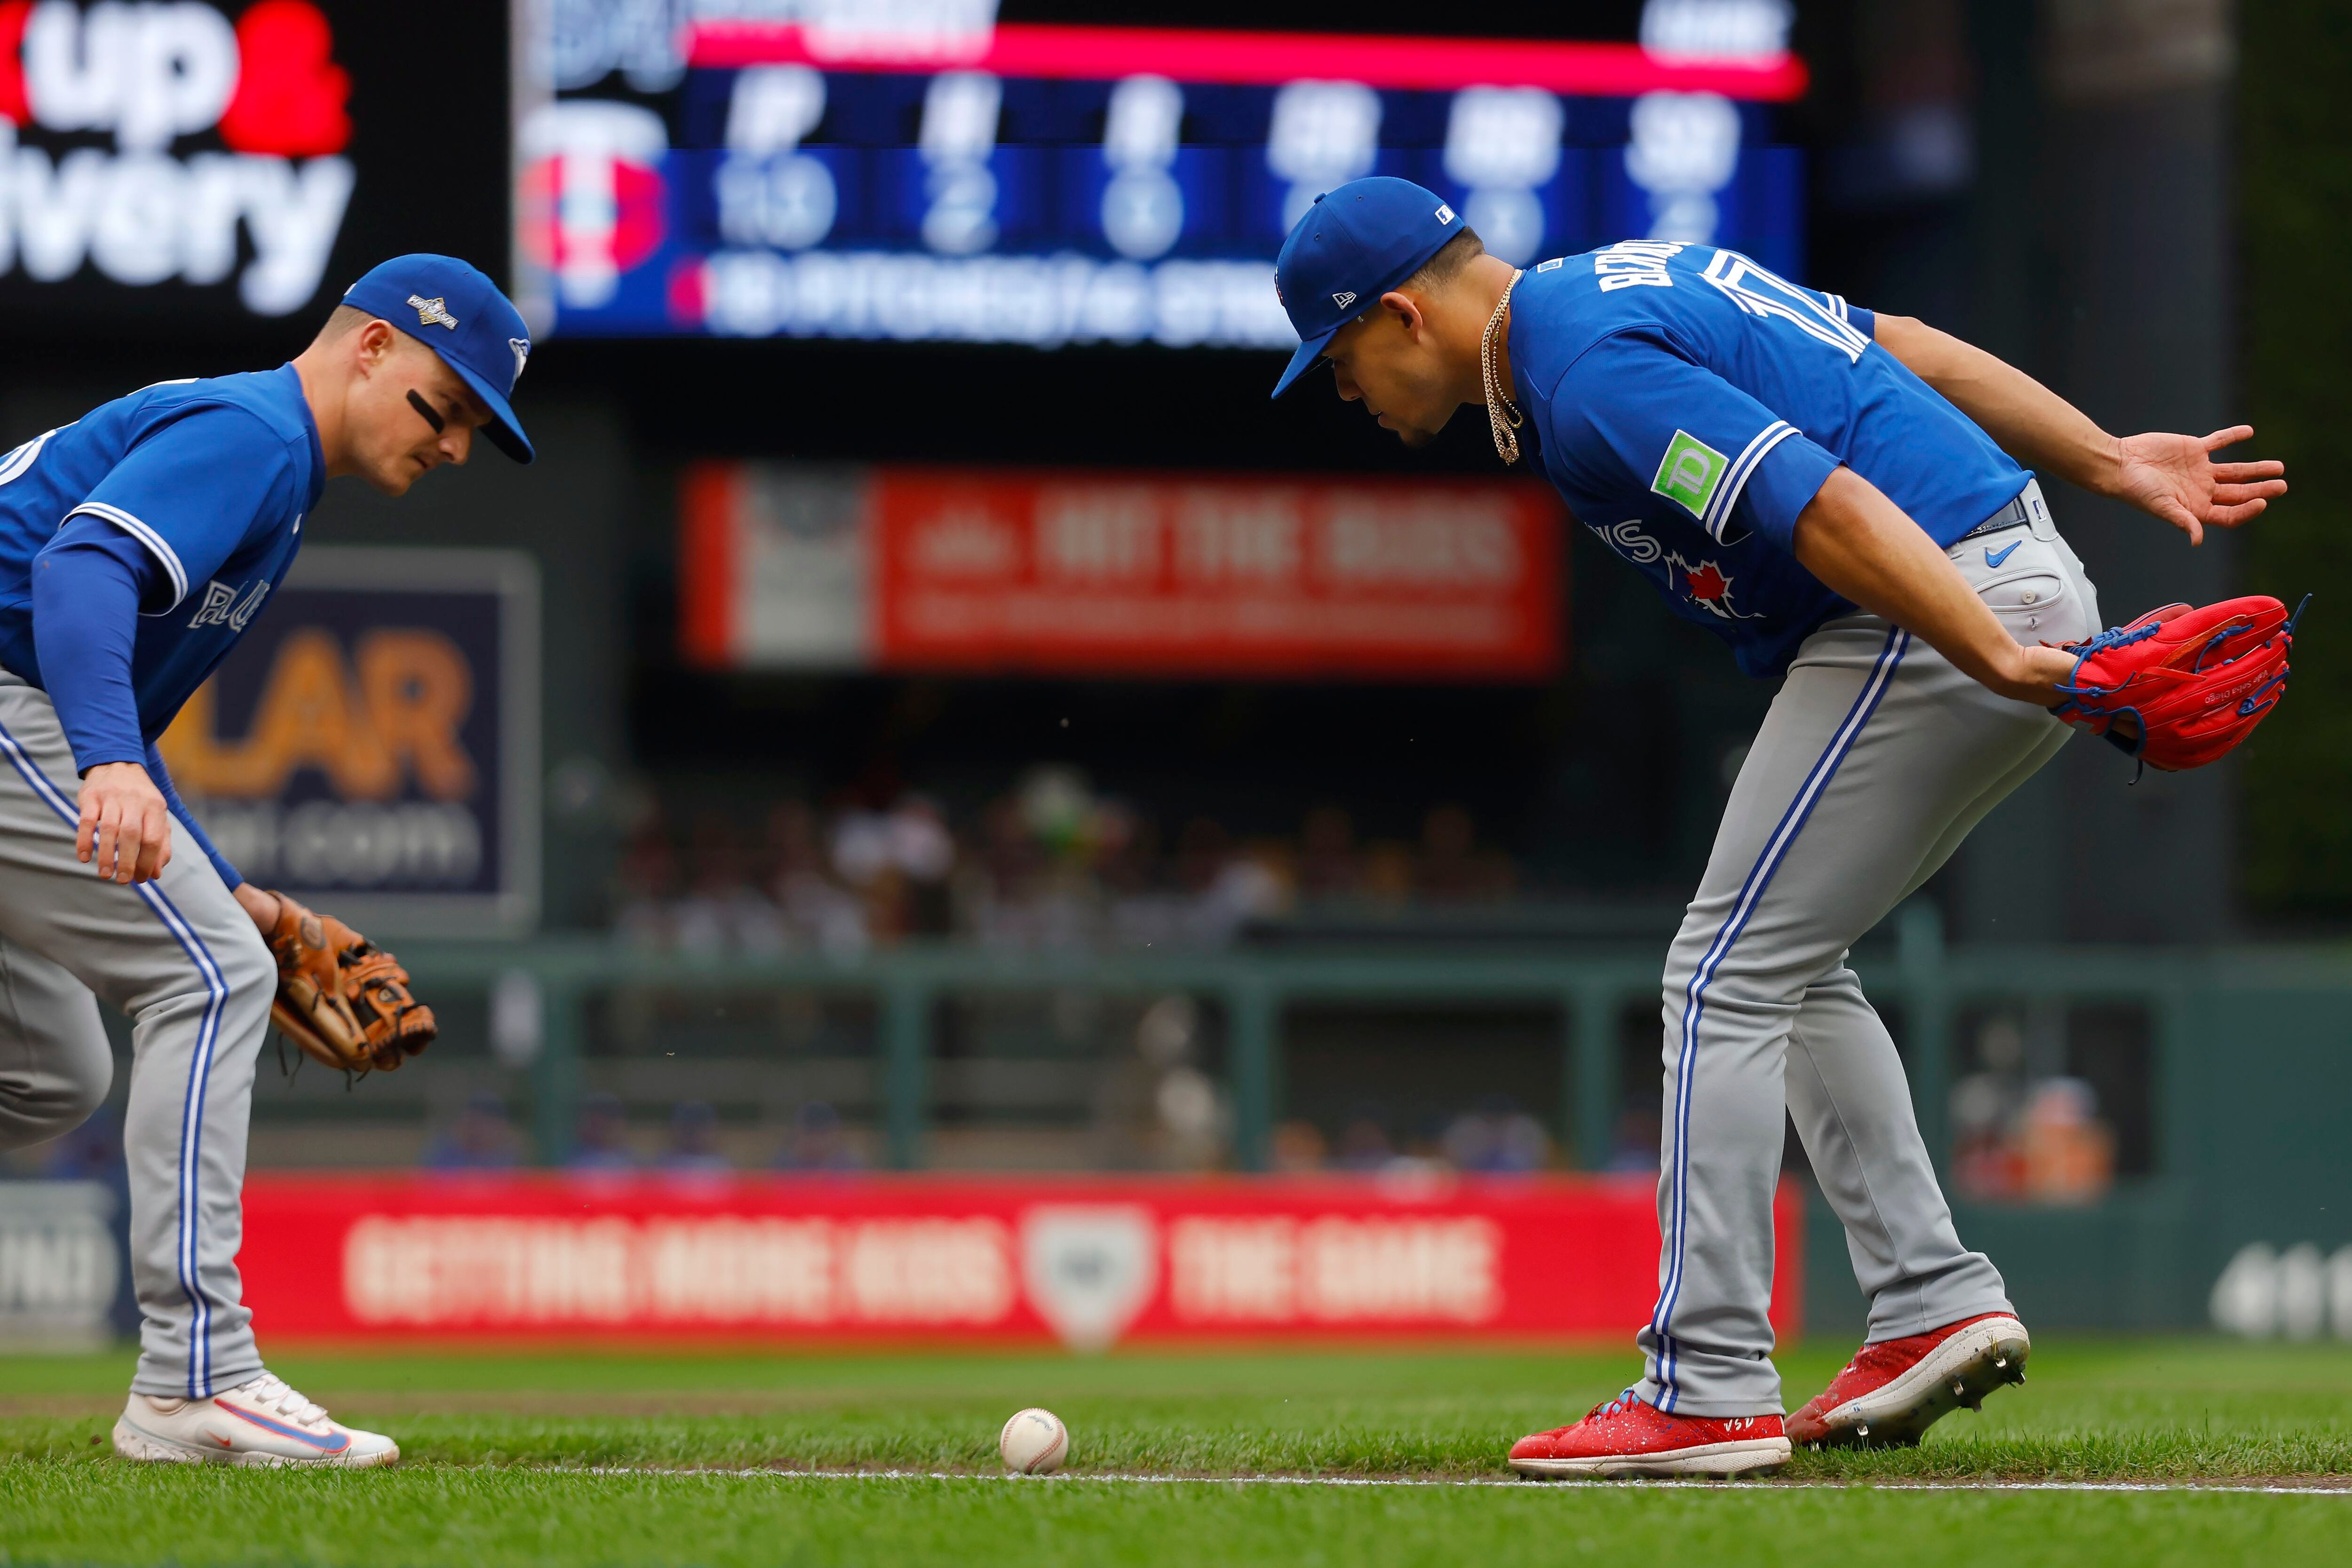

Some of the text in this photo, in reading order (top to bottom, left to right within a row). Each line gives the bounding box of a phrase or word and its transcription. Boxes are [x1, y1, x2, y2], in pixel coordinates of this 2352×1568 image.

[23, 1, 241, 147] up
[1696, 249, 1871, 364] 17
[1666, 448, 1711, 495] TD
[2205, 690, 2231, 703] Diego
